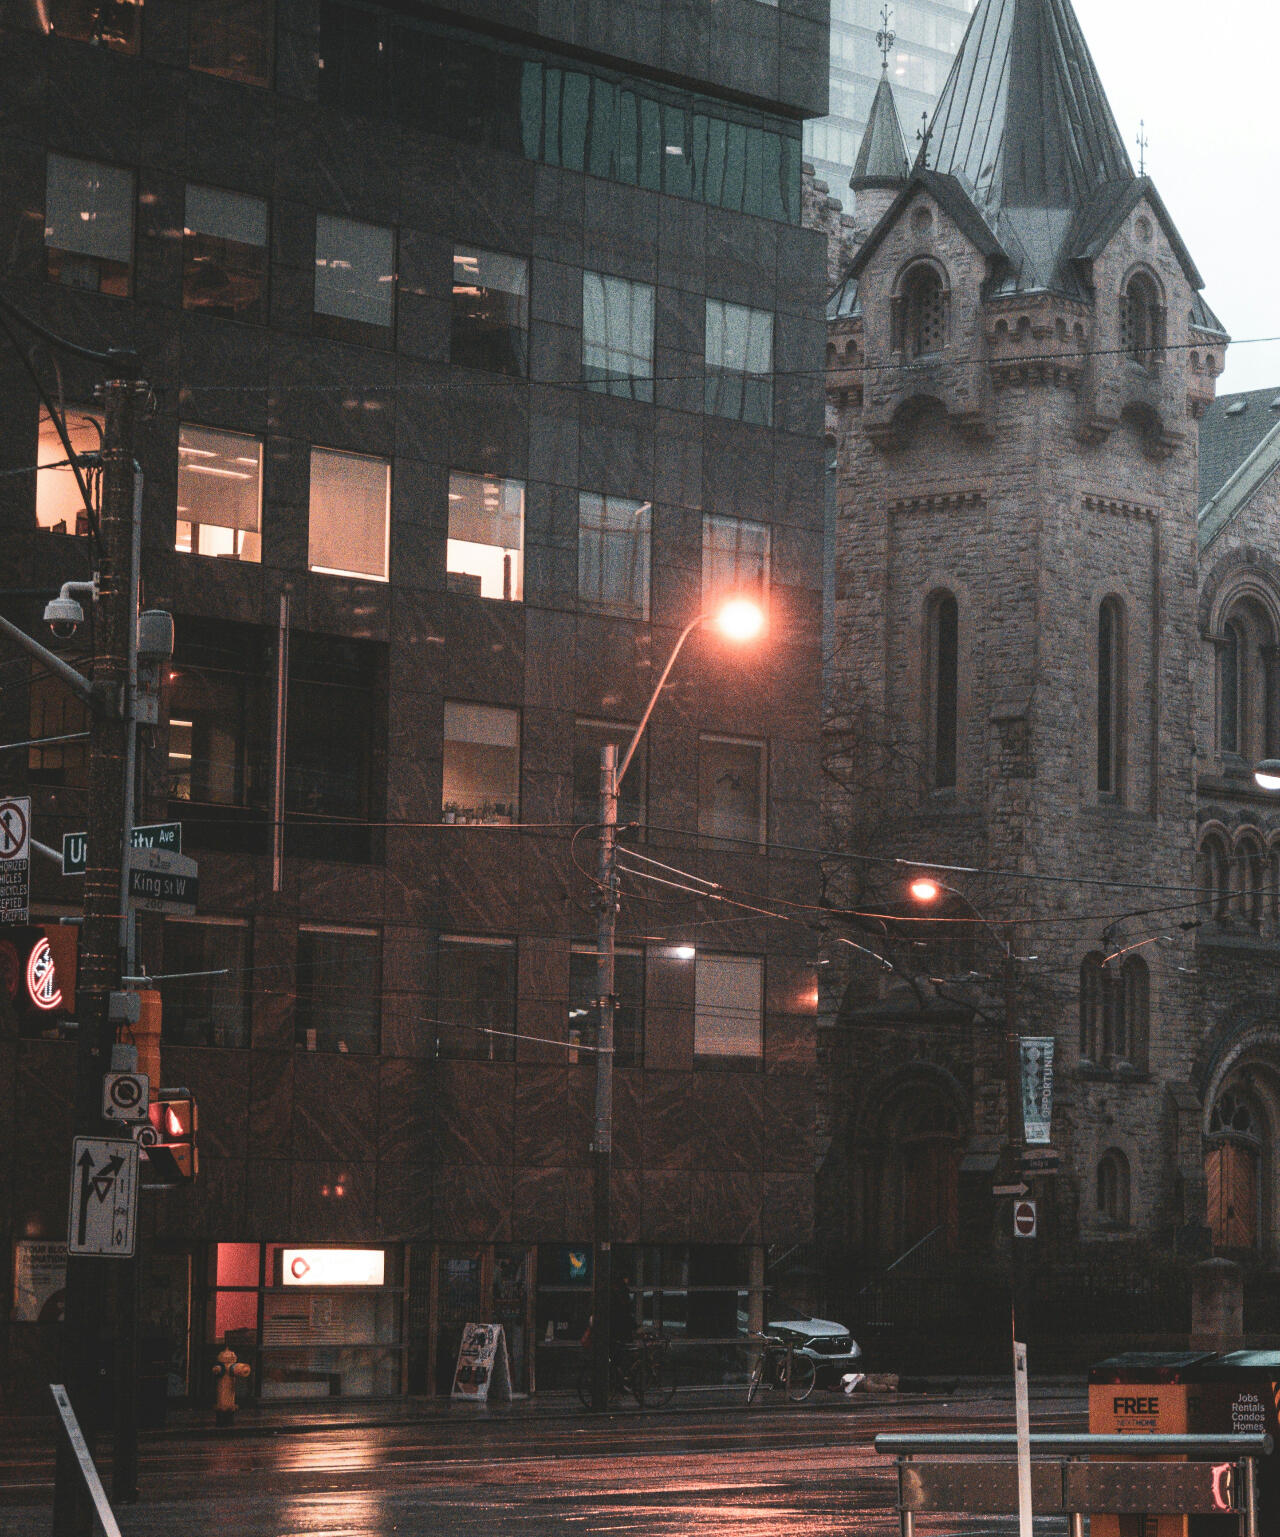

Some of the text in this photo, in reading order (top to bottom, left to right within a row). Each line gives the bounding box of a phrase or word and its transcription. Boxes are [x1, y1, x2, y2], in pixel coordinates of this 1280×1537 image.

[159, 829, 175, 843] Ave
[133, 872, 186, 896] King St W
[0, 898, 22, 909] EPTED
[1041, 1042, 1054, 1118] OPPORTUNITY
[1238, 1394, 1258, 1402] Jobs
[1113, 1397, 1160, 1414] FREE
[1231, 1402, 1266, 1411] Rentals
[1231, 1412, 1265, 1421] Condos
[1233, 1421, 1264, 1430] Homes
